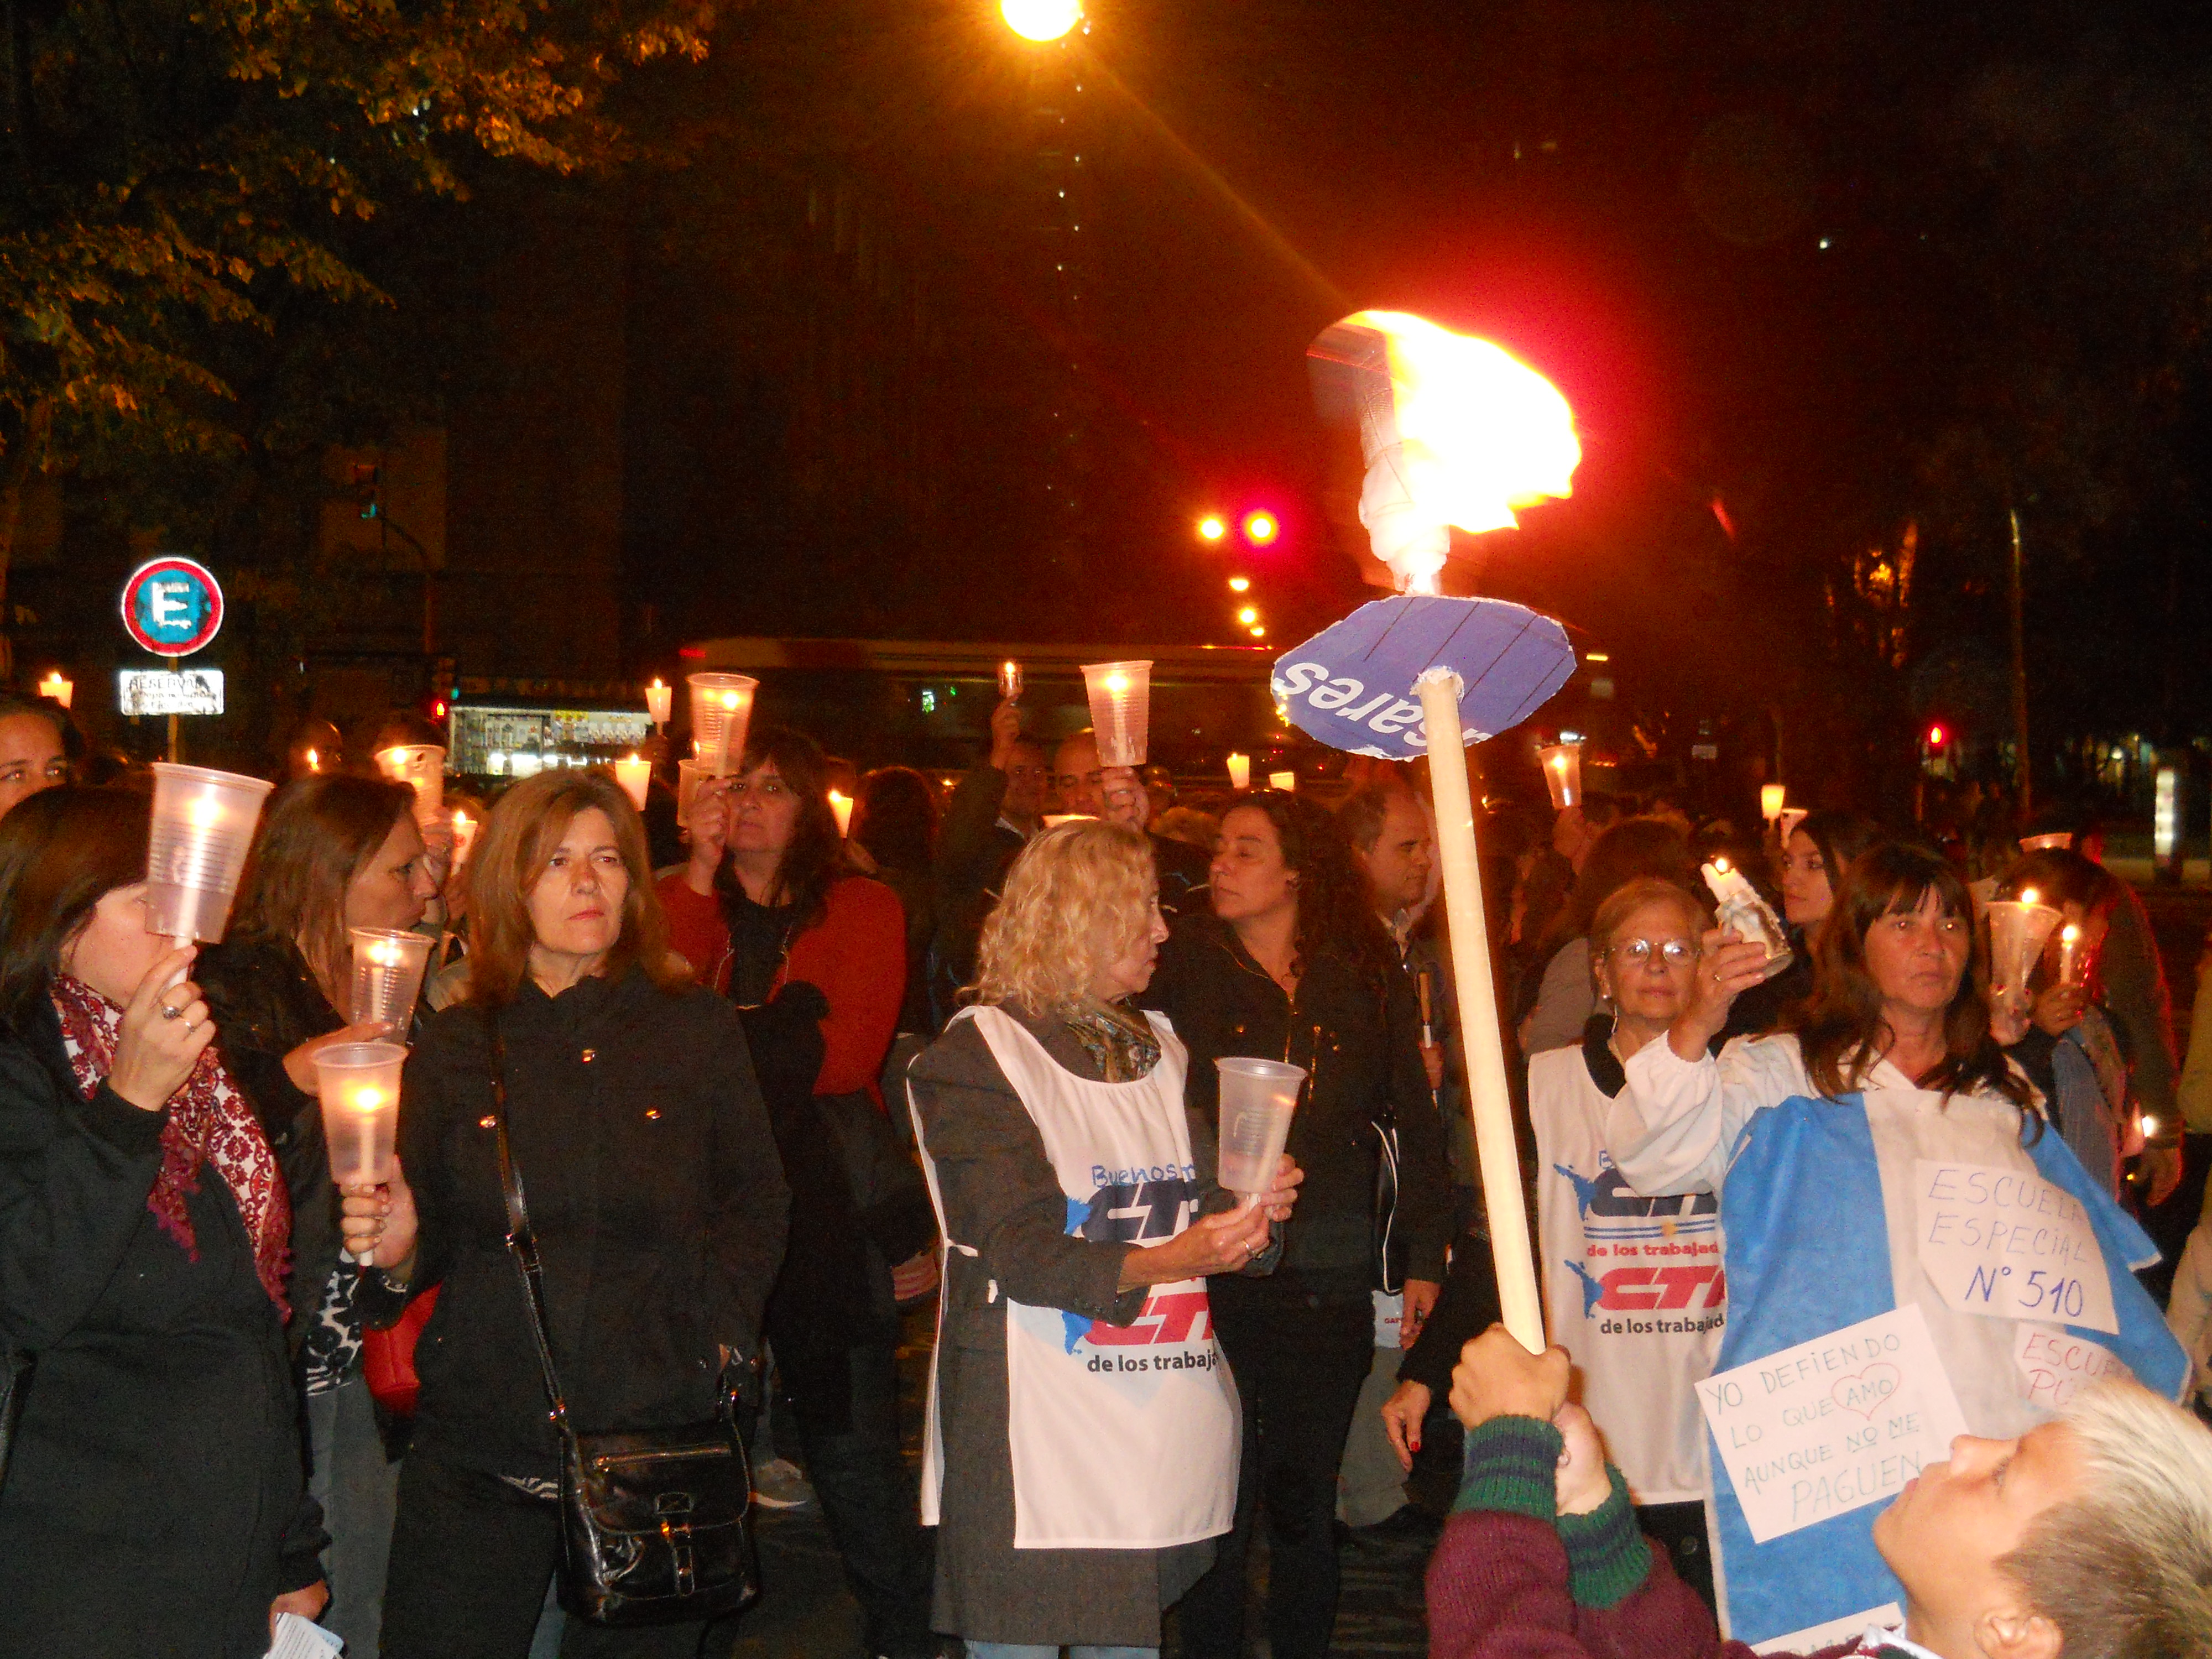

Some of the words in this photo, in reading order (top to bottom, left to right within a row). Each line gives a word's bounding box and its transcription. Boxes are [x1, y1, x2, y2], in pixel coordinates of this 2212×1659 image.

[152, 582, 191, 629] E
[1587, 1245, 1607, 1257] de
[1614, 1244, 1638, 1256] los
[2018, 1270, 2083, 1317] 510
[1600, 1319, 1623, 1334] de
[1627, 1319, 1652, 1333] los
[1087, 1355, 1113, 1373] de
[1118, 1354, 1149, 1371] los
[1706, 1382, 1743, 1415] YO
[1730, 1424, 1762, 1449] LO
[1782, 1396, 1834, 1427] QUE
[1846, 1379, 1893, 1406] AMO
[1744, 1444, 1834, 1495] AUNQUE
[1846, 1427, 1877, 1451] NO
[1888, 1412, 1919, 1437] ME
